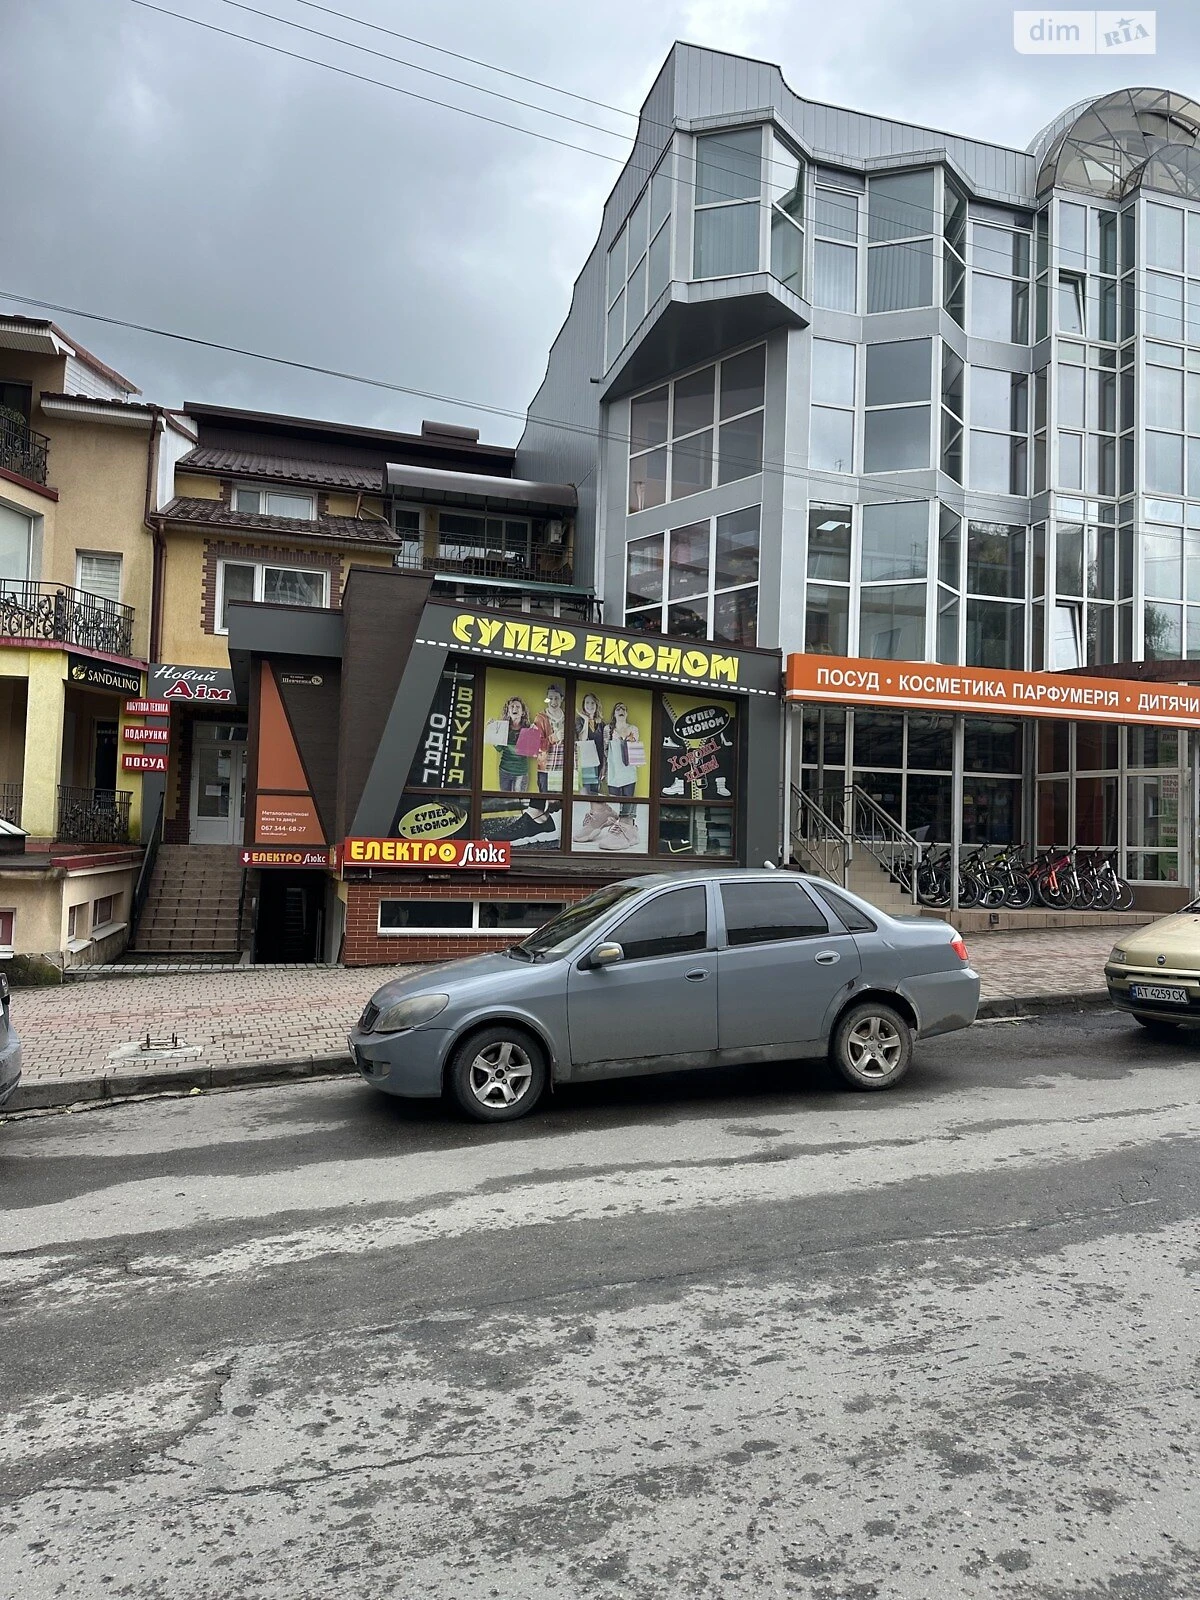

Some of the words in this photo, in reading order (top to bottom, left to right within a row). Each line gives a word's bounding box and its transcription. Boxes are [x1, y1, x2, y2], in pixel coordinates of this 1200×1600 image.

[452, 614, 576, 656] СУПЕР
[585, 634, 739, 682] ЕКОНОМ
[88, 670, 139, 691] SANDALINO
[153, 665, 218, 681] Новий
[163, 679, 231, 700] Дім
[817, 668, 880, 691] ПОСУД
[899, 674, 1007, 698] КОСМЕТИКА
[1012, 683, 1119, 706] ПАРФУМЕРІЯ
[681, 716, 725, 736] ЕКОНОМ
[685, 709, 716, 724] СУПЕР
[124, 728, 168, 740] ПОДАРУНКИ
[447, 686, 473, 784] ВЗУТТЯ
[422, 713, 447, 783] ОДЯГ
[125, 756, 165, 769] ПОСУД
[410, 816, 459, 835] ЕКОНОМ
[252, 852, 302, 863] ЕЛЕКТРО
[302, 853, 326, 865] Люкс
[350, 841, 457, 862] ЕЛЕКТРО
[457, 842, 506, 867] Люкс
[1137, 987, 1148, 998] AT
[1151, 988, 1171, 1000] 4259
[1172, 990, 1187, 1001] CK
